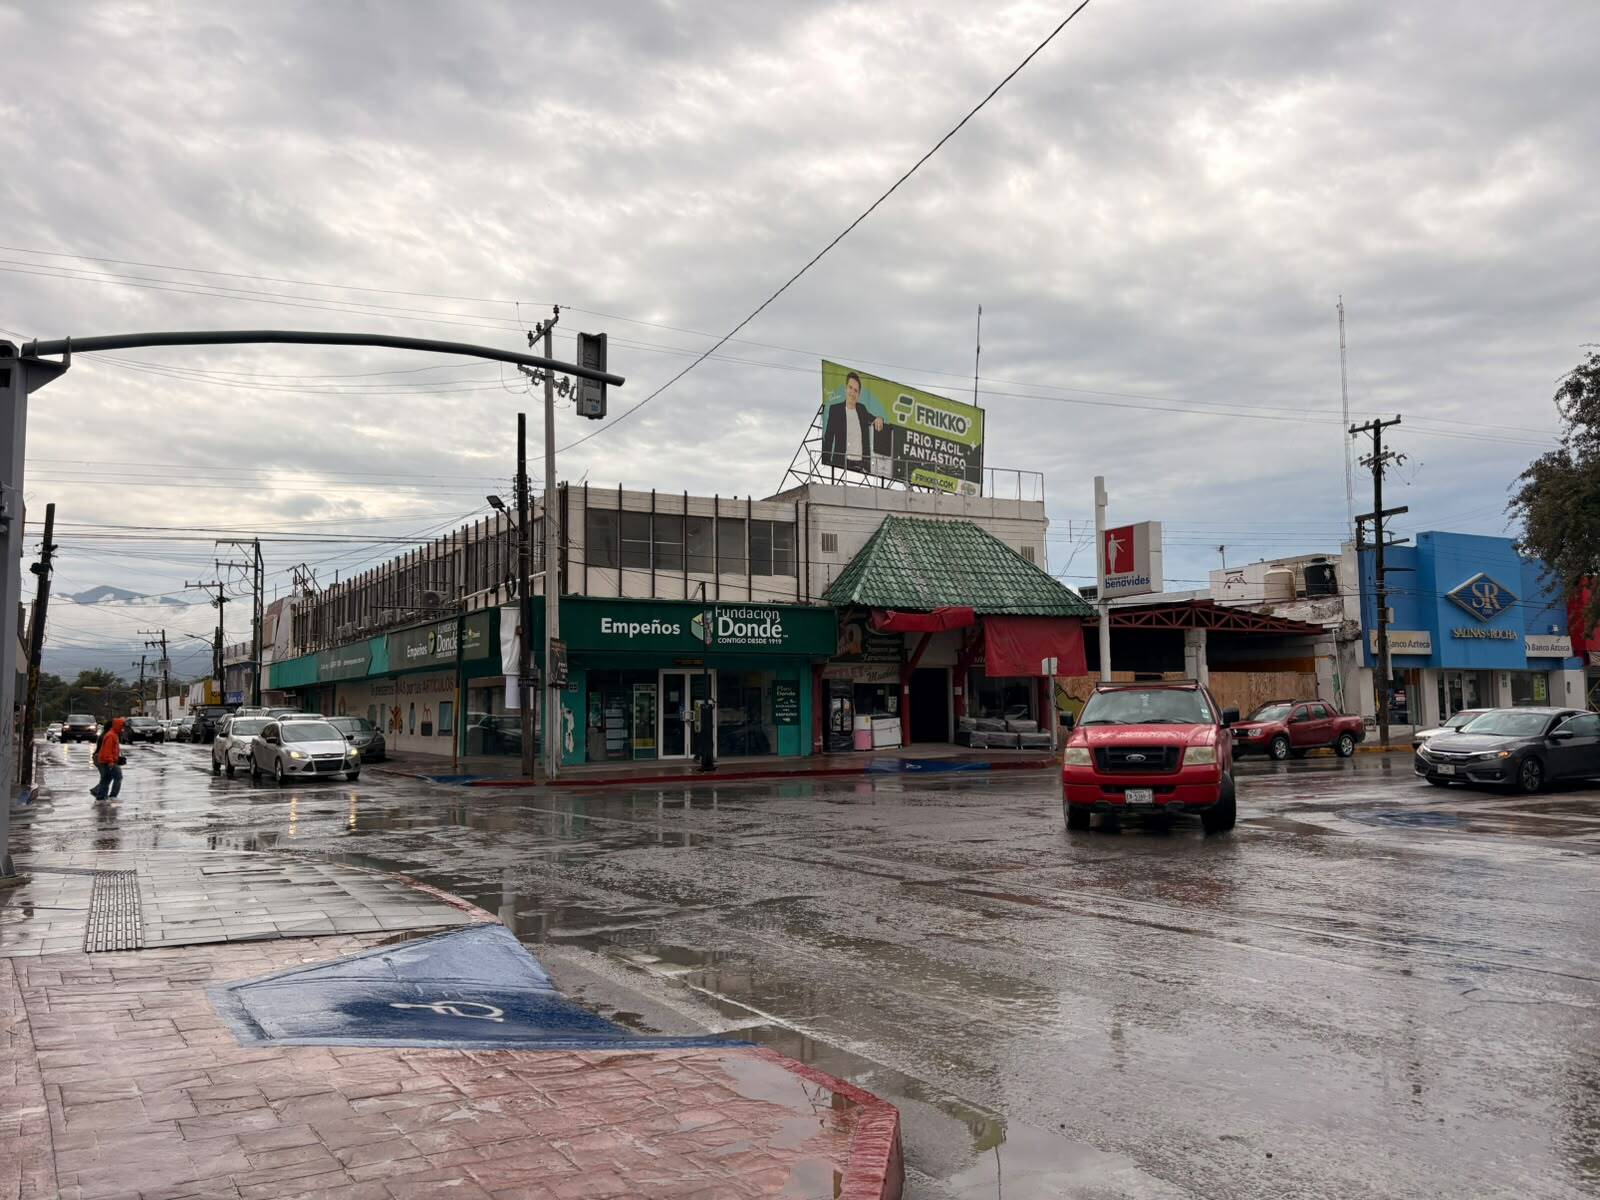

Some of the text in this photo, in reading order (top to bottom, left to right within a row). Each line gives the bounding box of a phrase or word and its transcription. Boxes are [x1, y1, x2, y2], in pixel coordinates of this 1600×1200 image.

[916, 406, 967, 434] FRIKKO
[1105, 575, 1151, 589] benavides
[715, 605, 780, 620] Fundación
[601, 617, 681, 638] Empeños
[718, 617, 783, 638] Dondé
[1531, 643, 1570, 652] Banco Azteca
